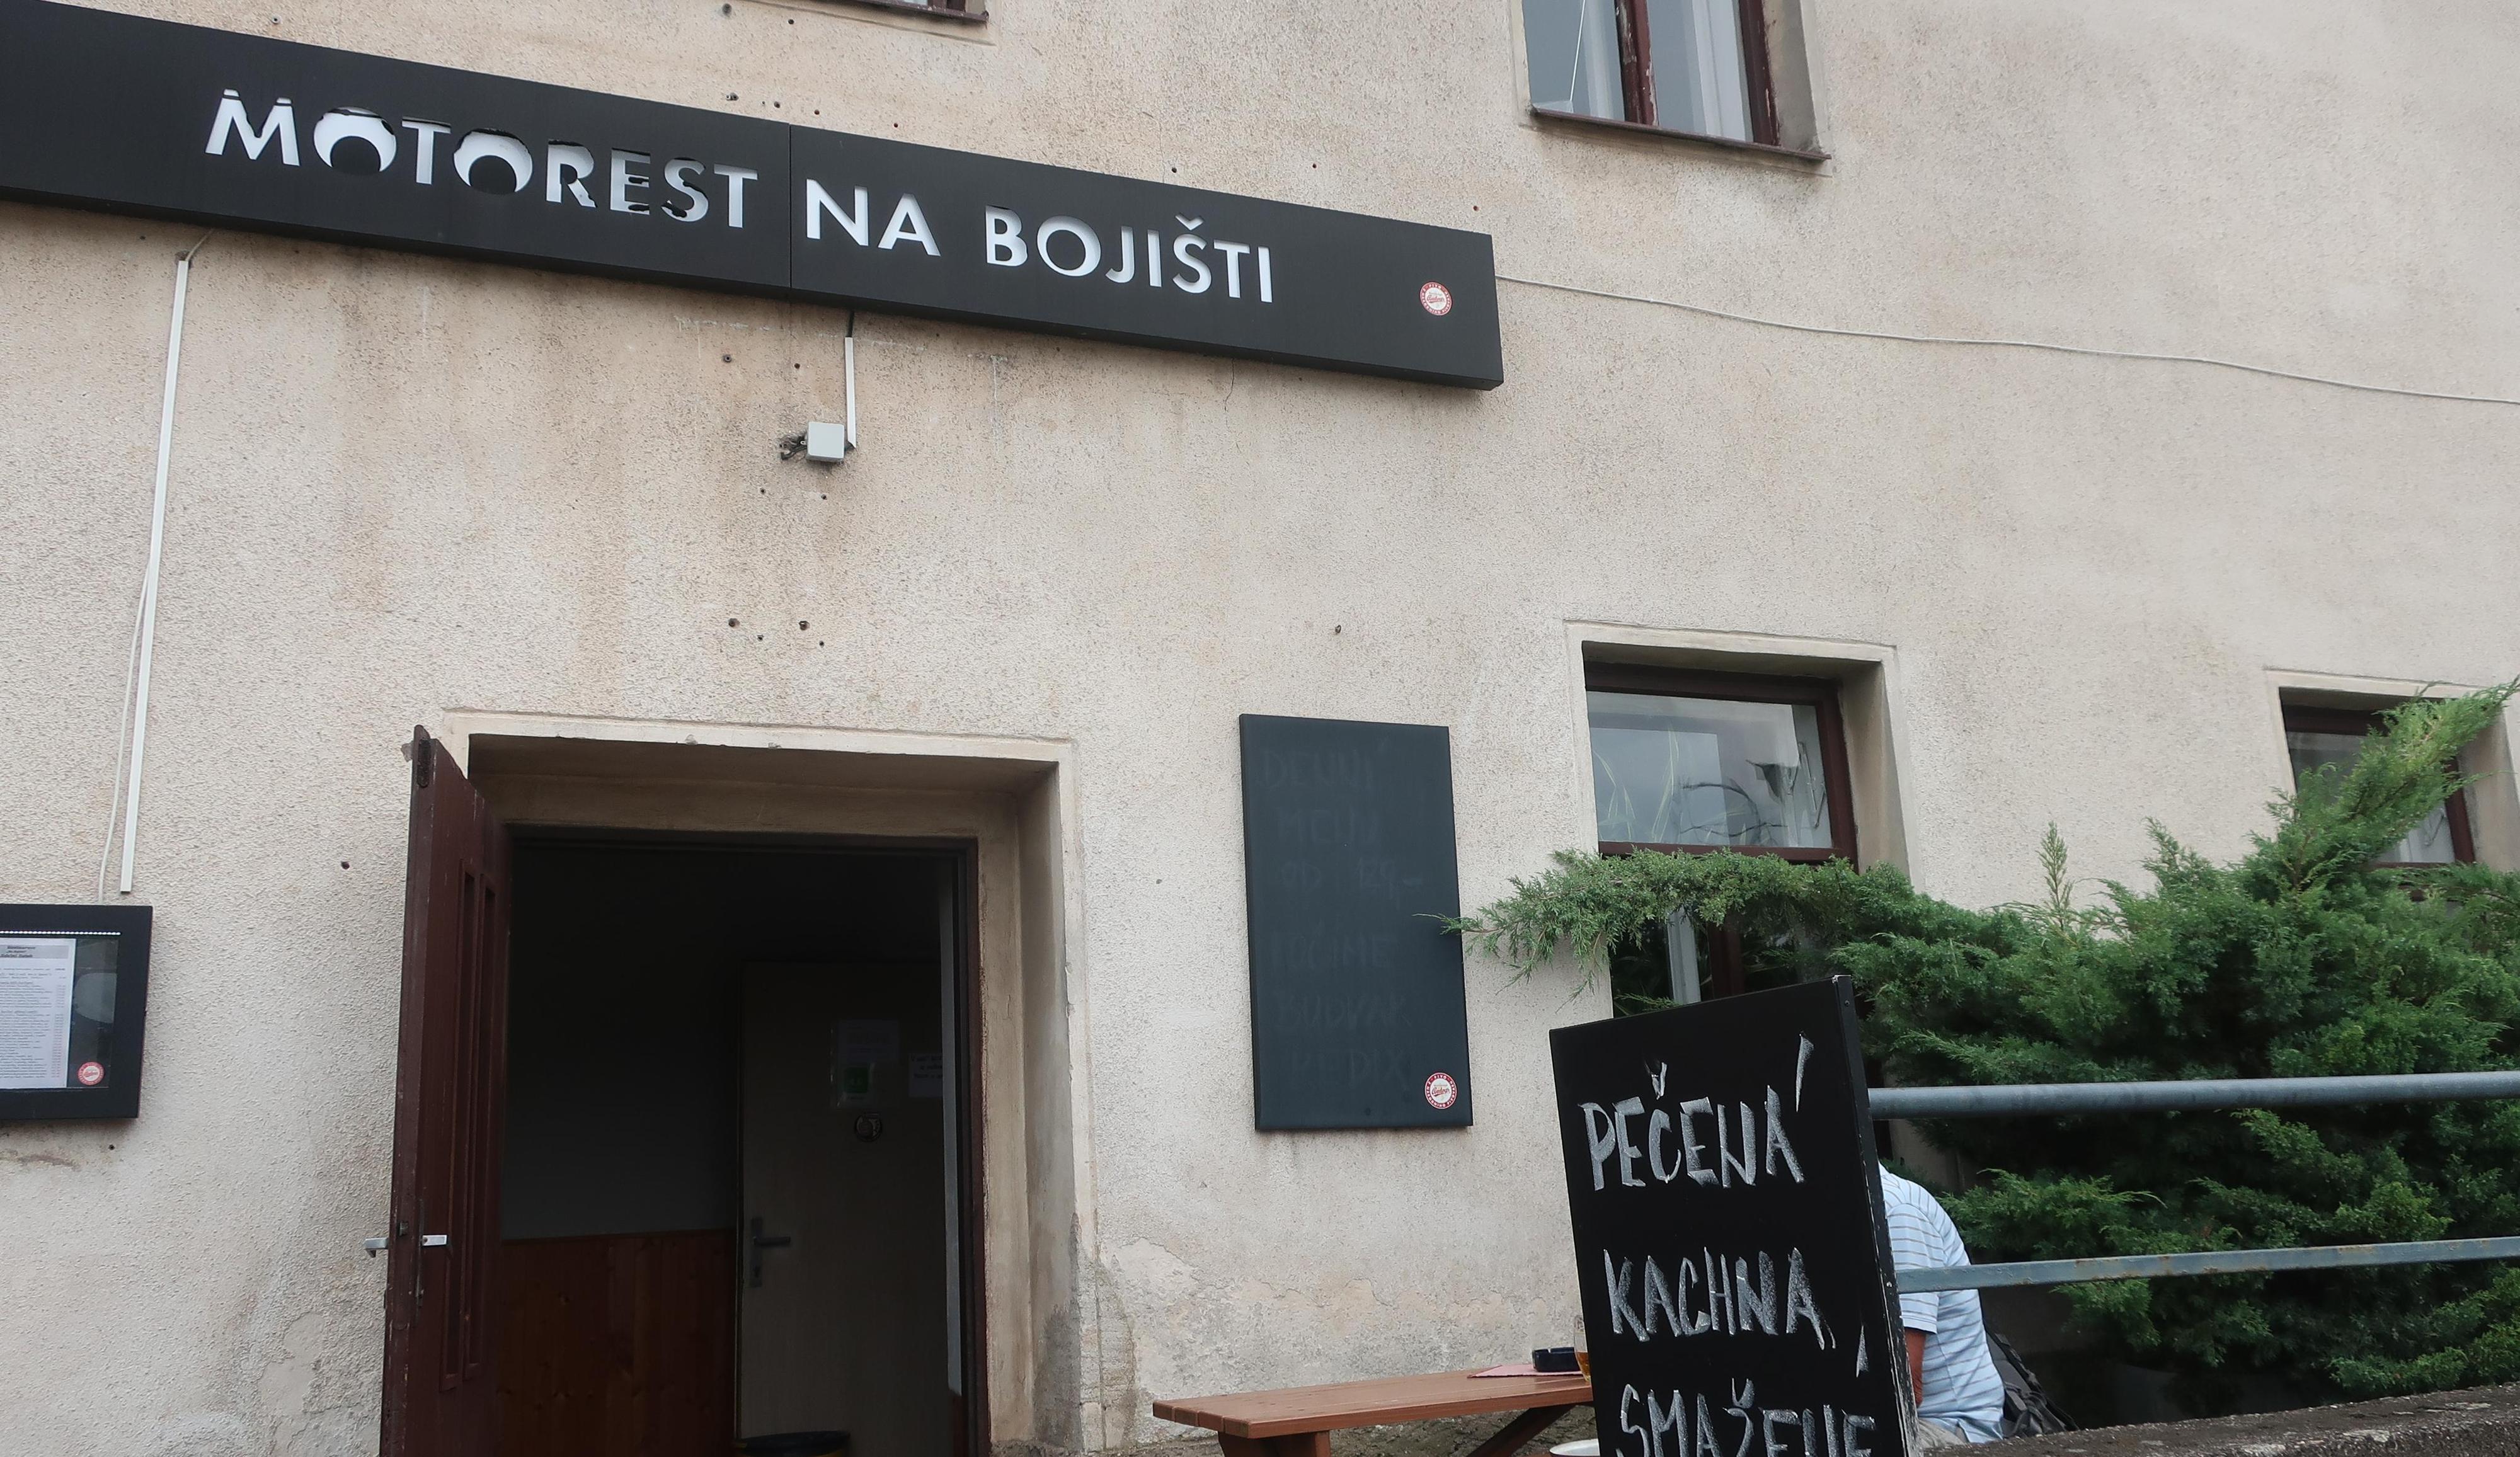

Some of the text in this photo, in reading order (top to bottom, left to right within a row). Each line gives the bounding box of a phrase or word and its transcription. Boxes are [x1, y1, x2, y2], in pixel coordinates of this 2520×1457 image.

[205, 88, 1273, 302] MOTOREST NA BOJIŠTI
[1578, 1032, 1815, 1191] PEČENÁ
